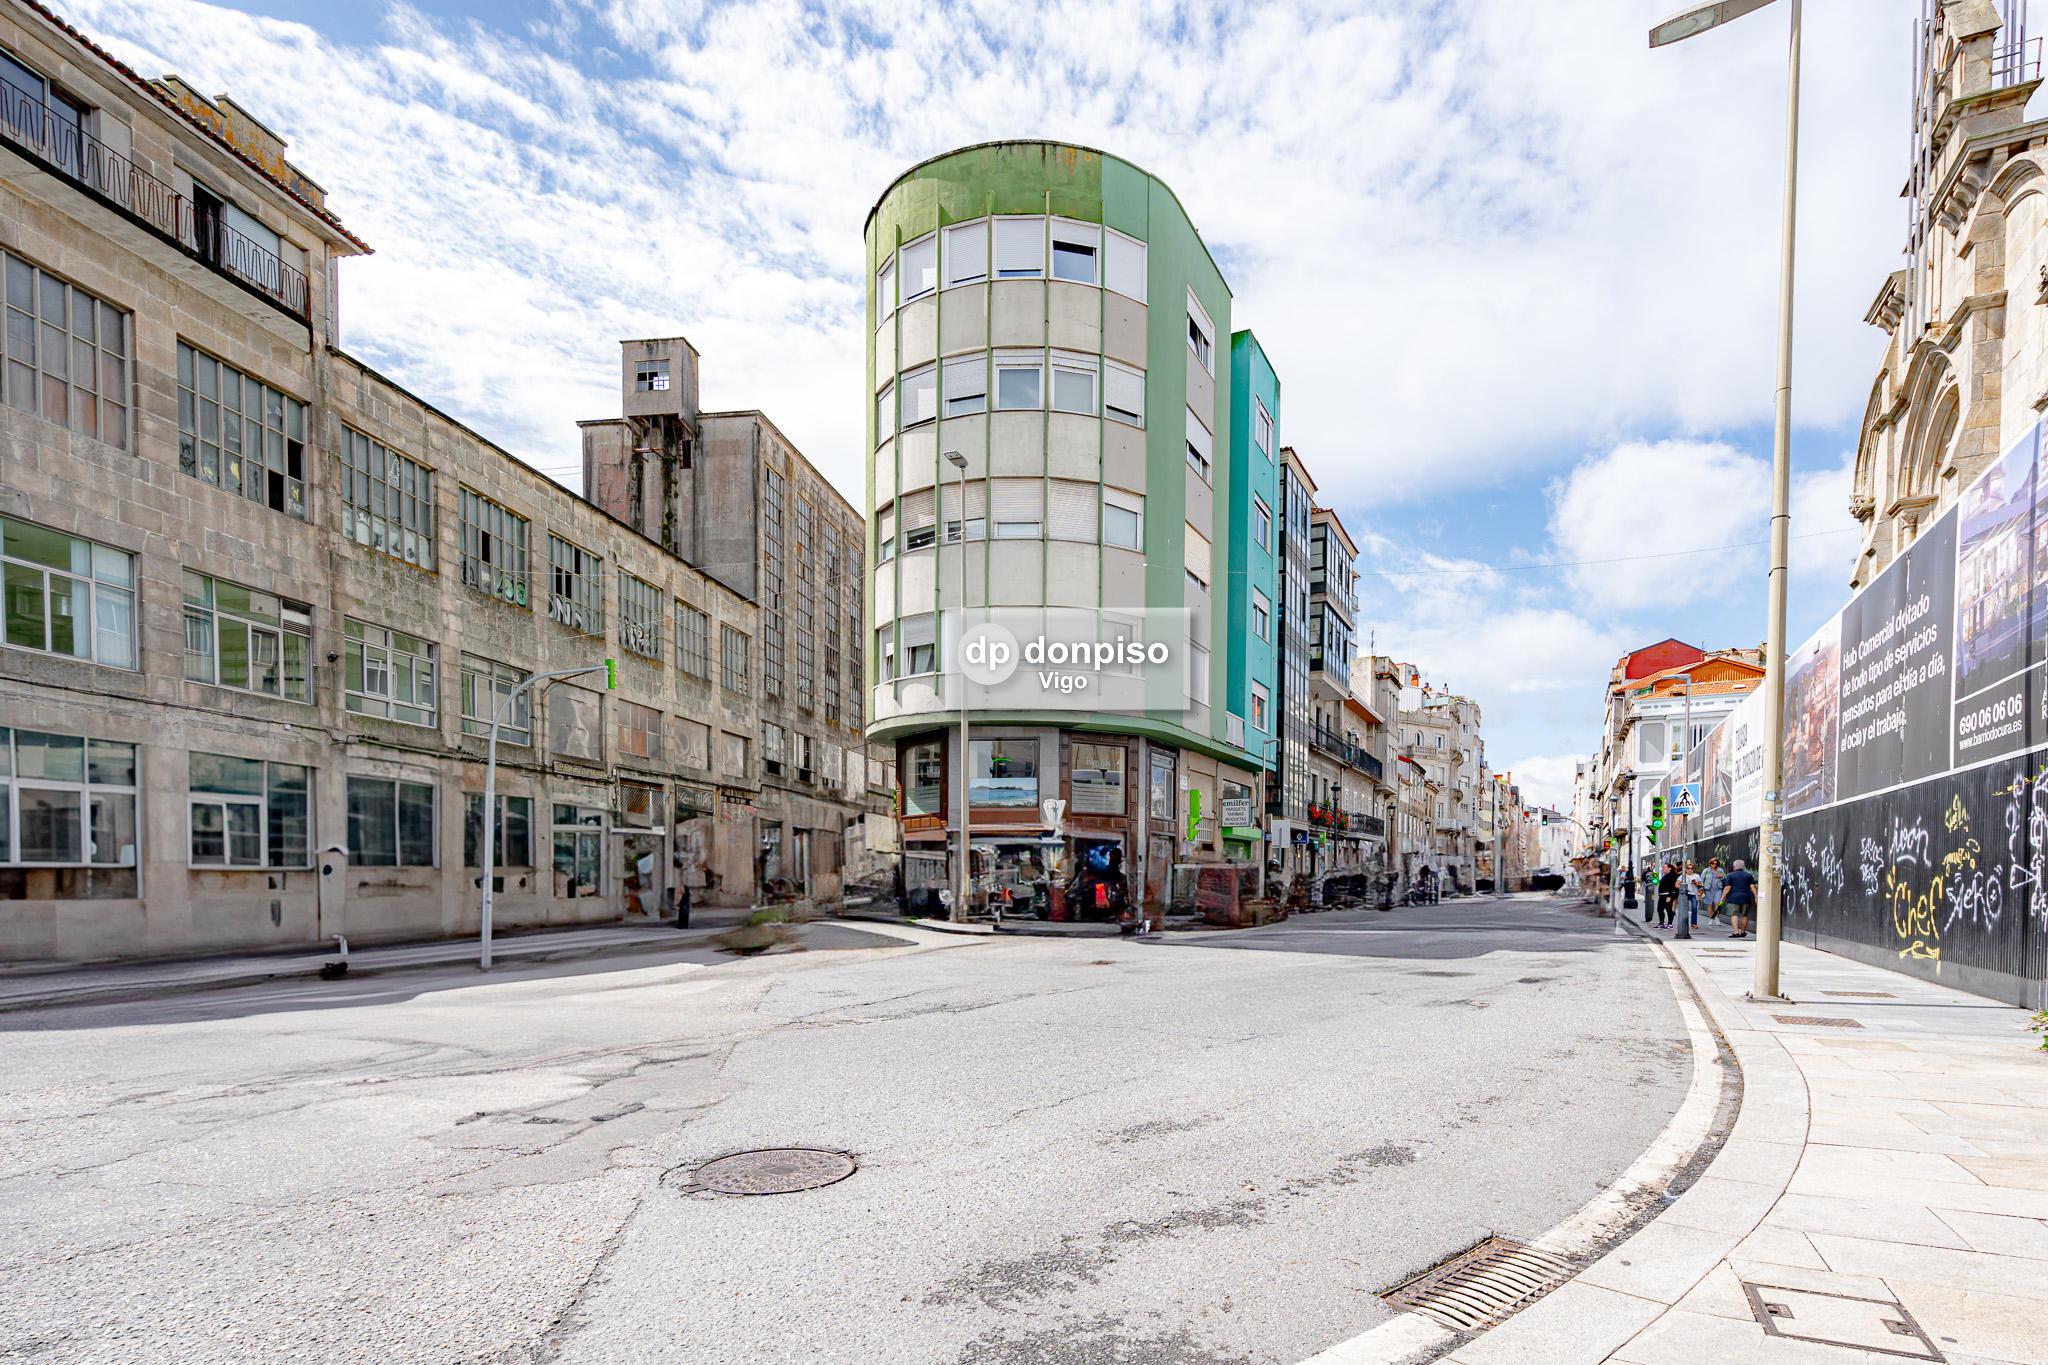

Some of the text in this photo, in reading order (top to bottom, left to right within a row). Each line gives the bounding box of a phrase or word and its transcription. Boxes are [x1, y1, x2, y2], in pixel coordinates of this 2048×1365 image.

[1843, 594, 1930, 671] Hub Comercial dotado
[1843, 623, 1938, 698] de todo tipo de servicios
[1842, 695, 1874, 729] pensados
[1875, 683, 1893, 711] para
[1903, 666, 1918, 690] día
[1919, 665, 1926, 684] a
[1927, 651, 1946, 679] día,
[1960, 712, 1977, 735] 690
[1978, 706, 1992, 728] 06
[1992, 700, 2006, 723] 06
[2007, 693, 2022, 717] 06
[1841, 736, 1847, 752] el
[1847, 725, 1862, 750] ocio
[1862, 727, 1868, 746] y
[1868, 718, 1875, 740] el
[1959, 720, 2022, 751] www.barriodocura.es
